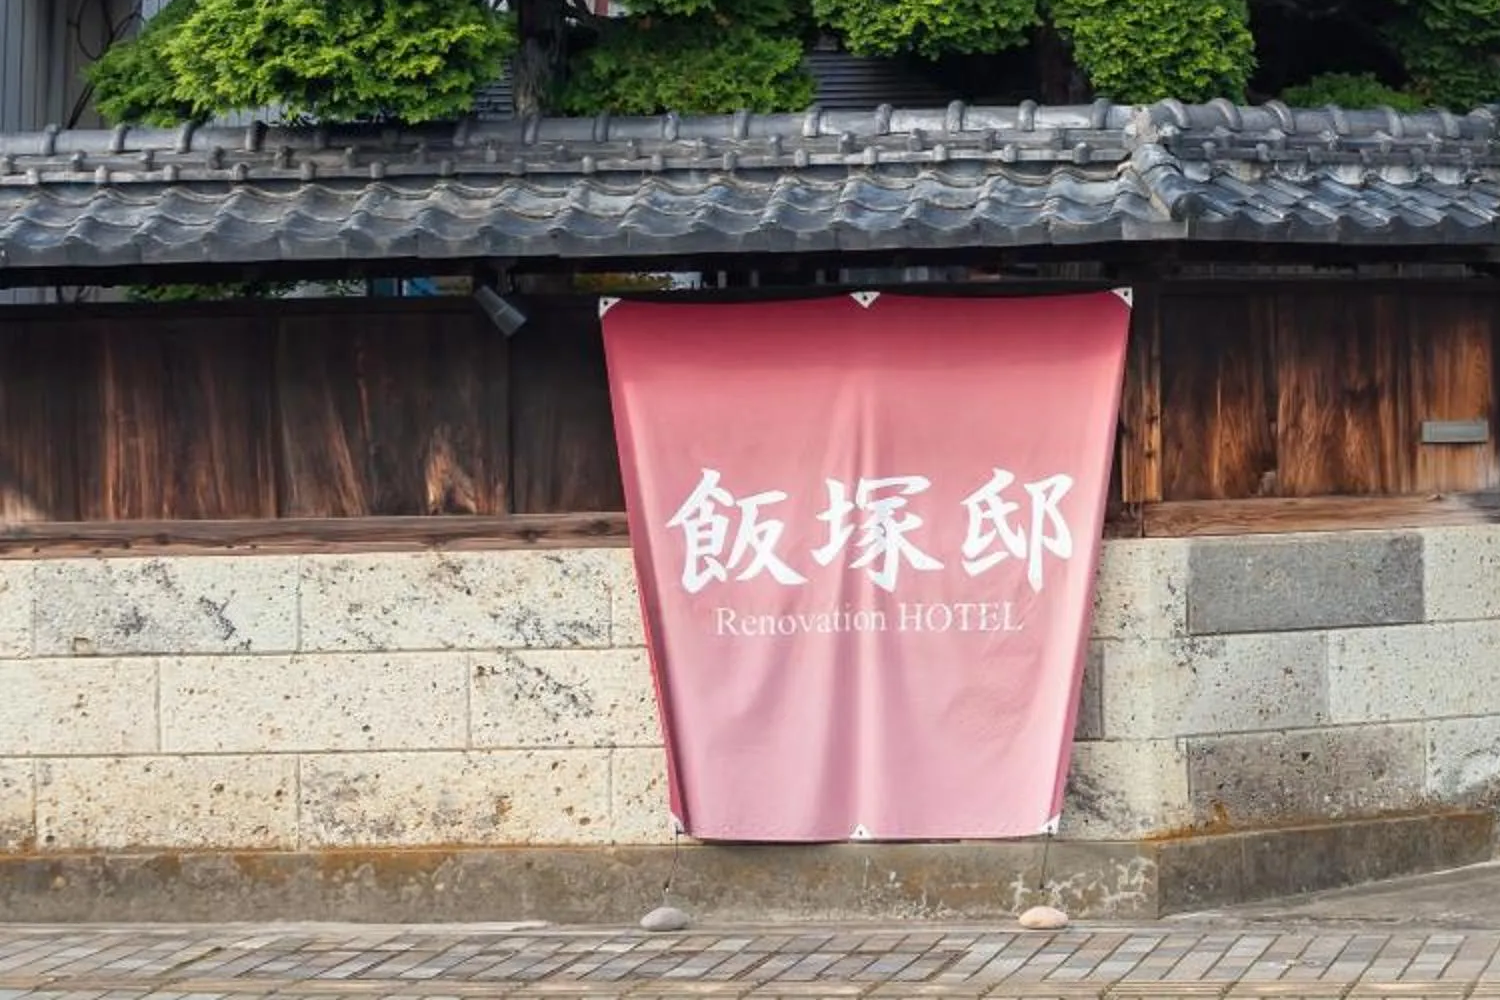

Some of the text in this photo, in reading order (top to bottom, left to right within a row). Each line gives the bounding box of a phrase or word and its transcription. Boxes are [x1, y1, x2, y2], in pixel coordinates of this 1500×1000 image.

[665, 467, 1075, 595] 飯塚邸
[715, 601, 1025, 637] Renovation HOTEL
